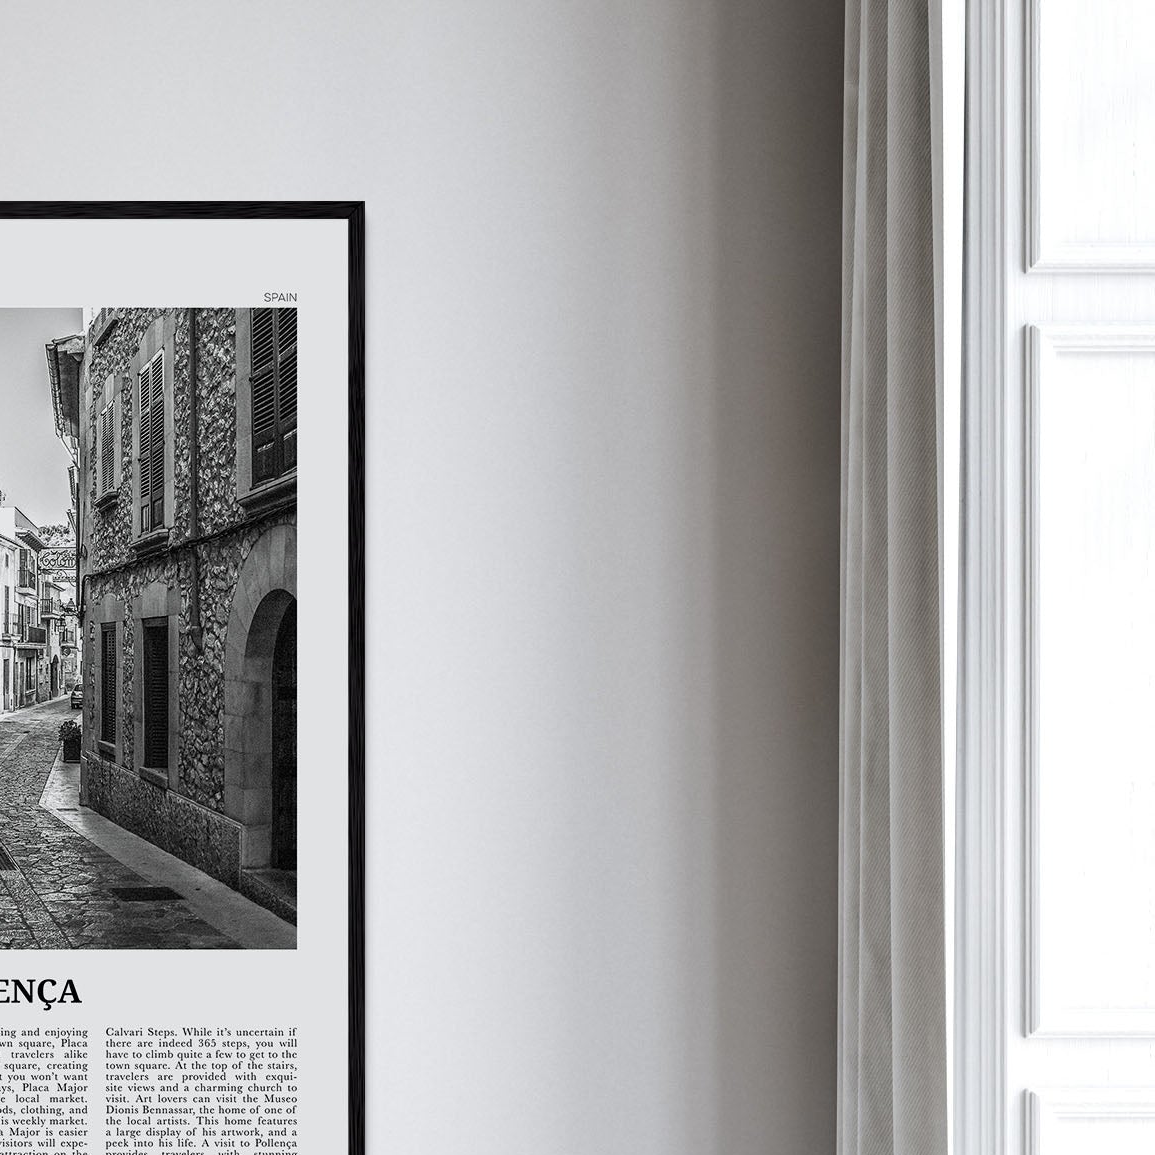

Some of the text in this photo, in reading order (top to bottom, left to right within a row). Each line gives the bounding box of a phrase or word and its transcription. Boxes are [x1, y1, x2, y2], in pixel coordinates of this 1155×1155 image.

[263, 291, 298, 303] SPAIN
[21, 1028, 40, 1037] and
[45, 1028, 88, 1039] enjoying
[106, 1028, 143, 1037] Calvari
[148, 1028, 178, 1039] Steps.
[182, 1028, 212, 1037] While
[236, 1028, 284, 1037] uncertain
[289, 1028, 298, 1037] if
[19, 1041, 55, 1050] square,
[61, 1039, 88, 1048] Placa
[106, 1039, 132, 1048] there
[159, 1039, 193, 1048] indeed
[198, 1039, 217, 1048] 365
[222, 1040, 250, 1050] steps,
[255, 1041, 274, 1050] you
[279, 1039, 297, 1048] will
[11, 1050, 55, 1059] travelers
[64, 1050, 88, 1059] alike
[4, 1063, 41, 1073] square,
[46, 1061, 88, 1073] creating
[106, 1072, 149, 1081] travelers
[182, 1072, 227, 1084] provided
[235, 1072, 257, 1081] with
[265, 1072, 297, 1084] exqui-
[105, 1094, 130, 1103] visit.
[135, 1094, 152, 1103] Art
[158, 1094, 188, 1103] lovers
[216, 1094, 237, 1103] visit
[243, 1094, 259, 1103] the
[264, 1094, 298, 1103] Museo
[20, 1105, 65, 1117] clothing,
[69, 1105, 88, 1114] and
[12, 1116, 46, 1128] weekly
[50, 1116, 88, 1125] market.
[106, 1116, 298, 1125] the local artists. This home features
[37, 1139, 56, 1148] will
[60, 1141, 88, 1150] expe-
[106, 1139, 298, 1150] peek into his life. A visit to Pollença
